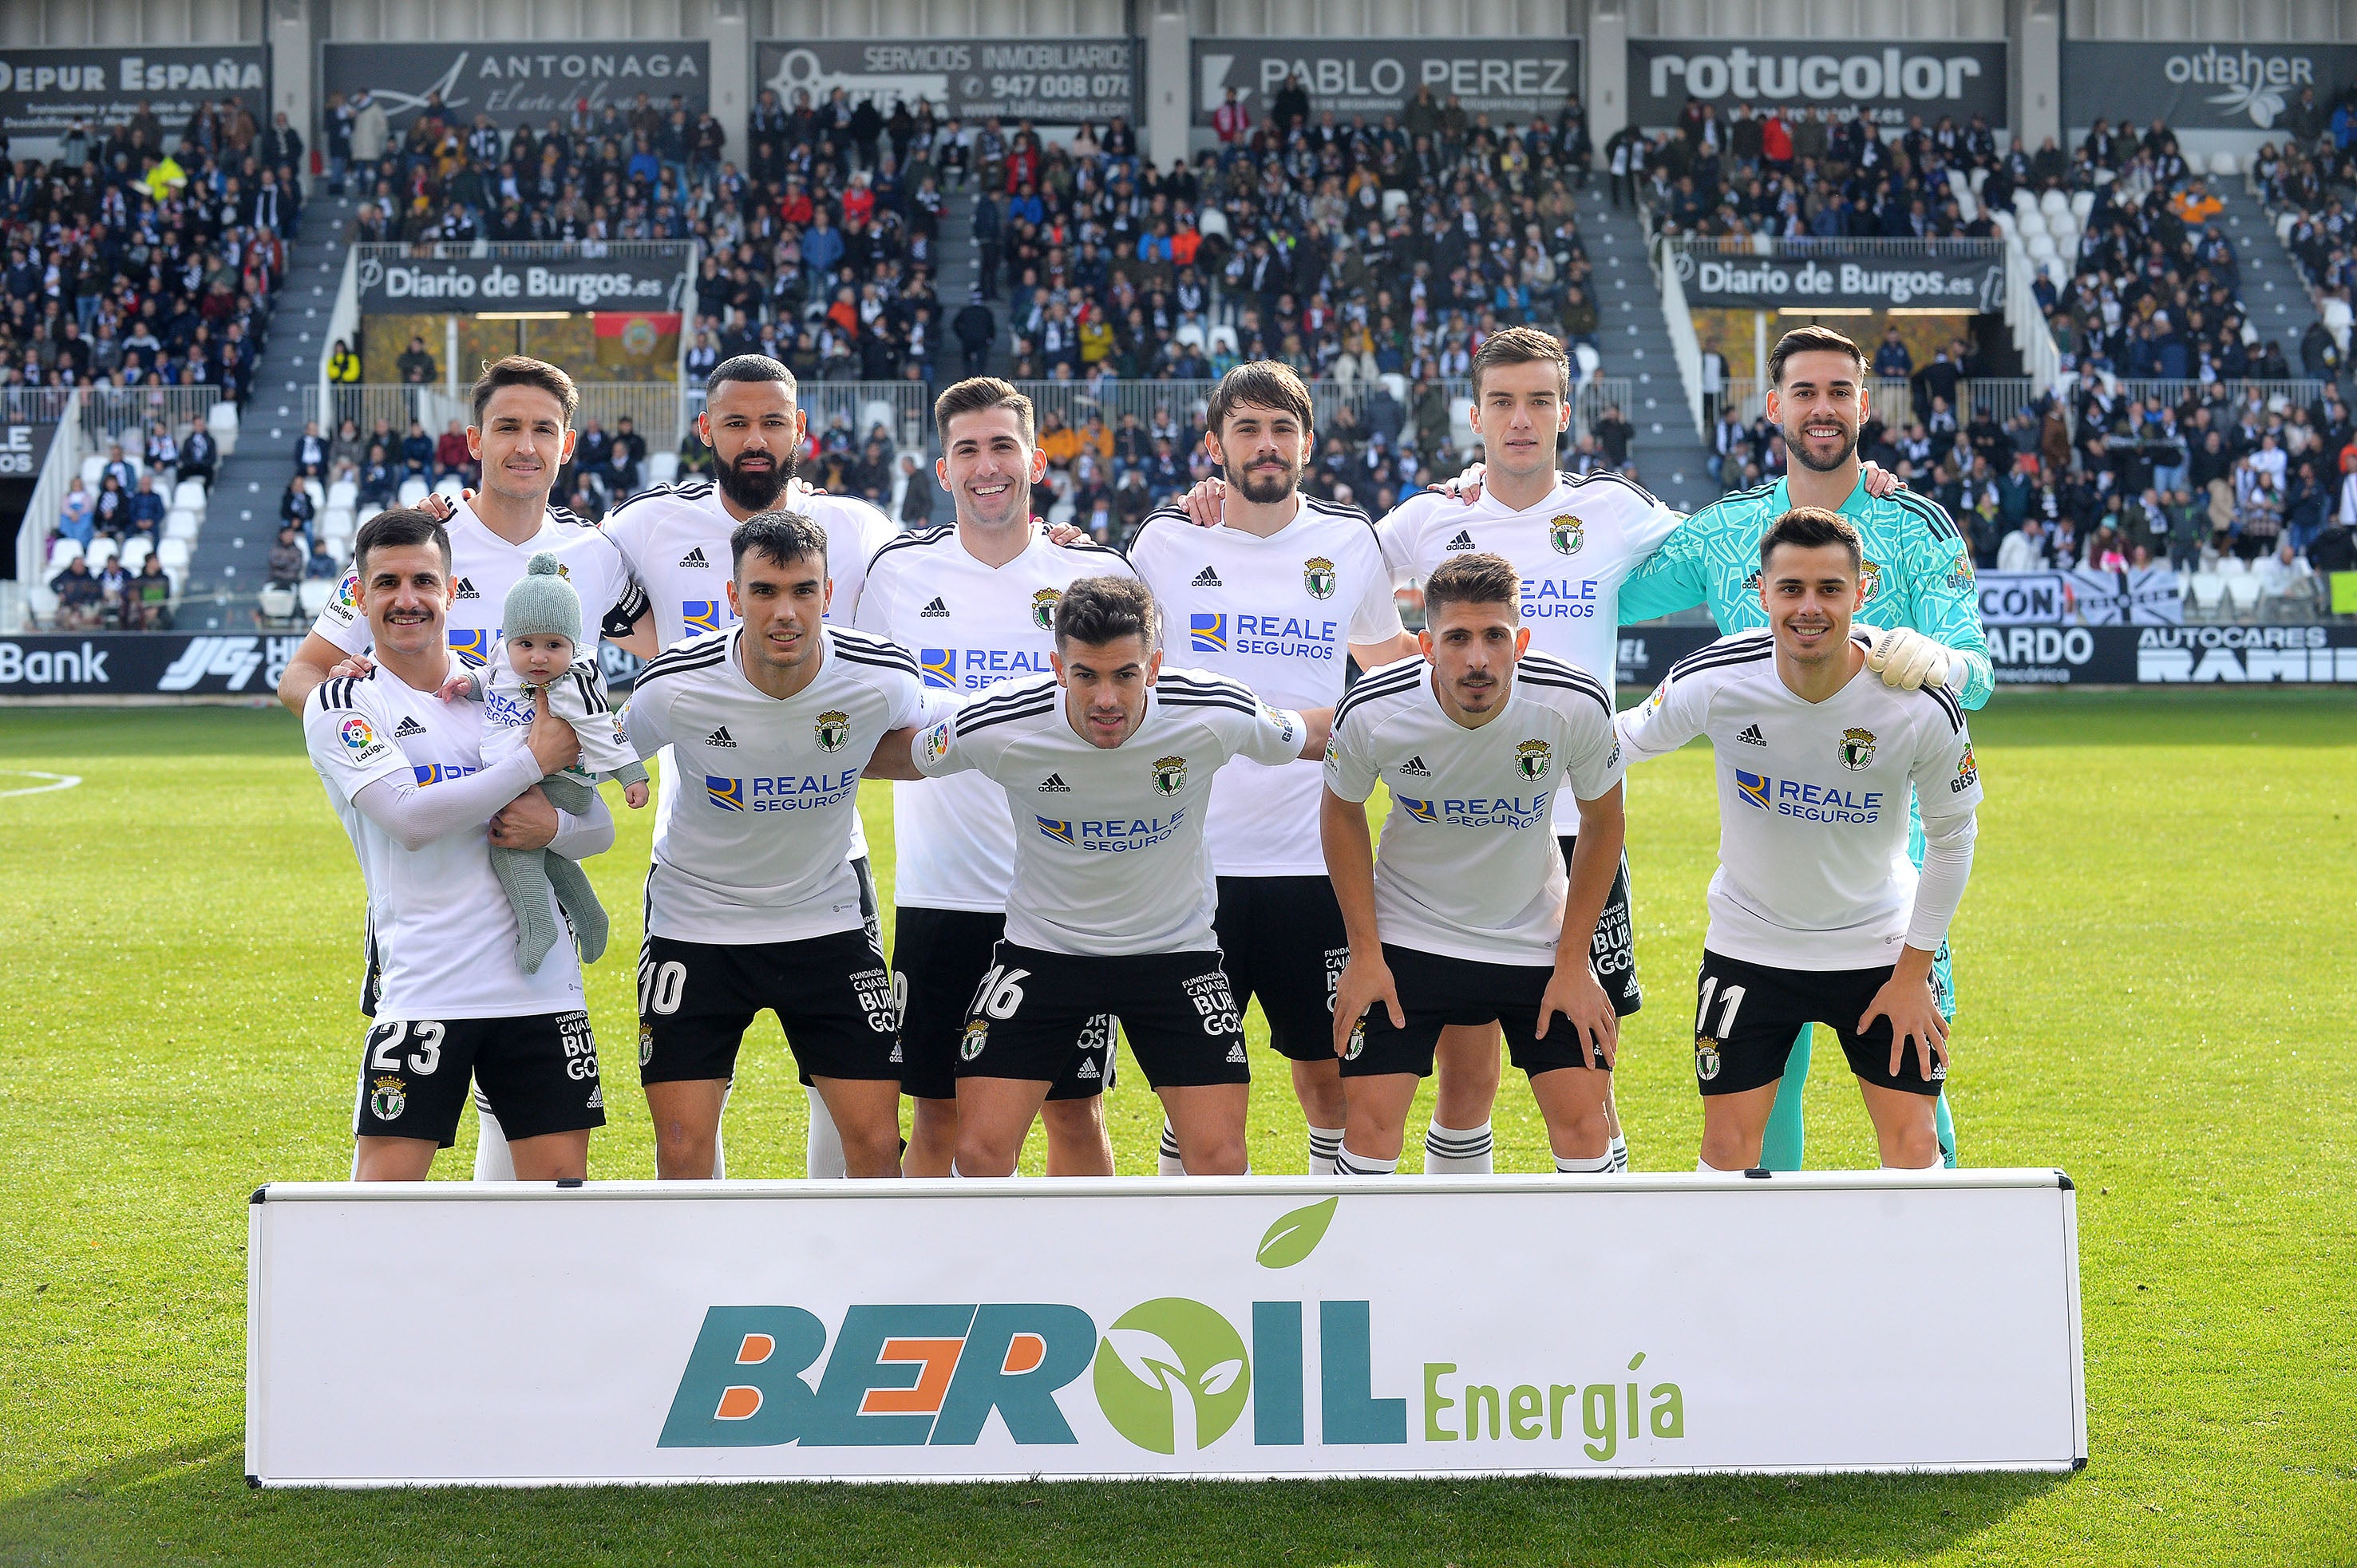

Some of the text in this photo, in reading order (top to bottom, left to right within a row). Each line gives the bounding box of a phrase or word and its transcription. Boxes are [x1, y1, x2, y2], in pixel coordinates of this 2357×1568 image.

[479, 54, 699, 78] ANTONAGA
[864, 45, 971, 70] SERVICIOS
[1260, 58, 1569, 95] PABLO PEREZ
[1650, 46, 1981, 99] rotucolor
[991, 73, 1035, 98] 947
[1040, 73, 1088, 98] 008
[386, 264, 662, 306] Diario de Burgos.es
[1699, 261, 1974, 303] Diario de Burgos.es
[679, 559, 710, 569] adidas
[1191, 578, 1223, 587] adidas
[1520, 579, 1598, 600] EALE
[456, 590, 480, 599] didas
[330, 602, 354, 622] LaLiga
[920, 609, 950, 618] adidas
[1520, 603, 1595, 618] GUROS
[1237, 614, 1338, 642] REALE
[2138, 627, 2327, 649] AUTOCARES
[1236, 639, 1334, 661] SEGUROS
[966, 650, 1054, 673] REAL
[394, 725, 427, 738] adidas
[705, 736, 738, 749] adidas
[1736, 733, 1768, 748] adidas
[355, 743, 385, 762] LaLiga
[753, 768, 858, 797] REALE
[1399, 767, 1432, 777] adidas
[1038, 783, 1071, 793] adidas
[1779, 779, 1884, 810] REALE
[753, 788, 852, 812] SEGUROS
[1444, 791, 1549, 815] REALE
[1082, 807, 1187, 838] REALE
[1446, 808, 1544, 831] SEGUROS
[1778, 802, 1879, 823] SEGUROS
[1599, 901, 1625, 918] NDACIÓN
[1324, 946, 1351, 958] FUNDA
[849, 967, 885, 981] FUNDACIÓN
[639, 961, 686, 1016] 10
[973, 965, 1032, 1019] 16
[1696, 976, 1746, 1039] 11
[868, 1010, 895, 1032] GO
[1204, 1013, 1243, 1035] GOS
[370, 1021, 446, 1075] 23
[1077, 1029, 1105, 1049] OS
[656, 1296, 1686, 1463] BEROIL Energía
